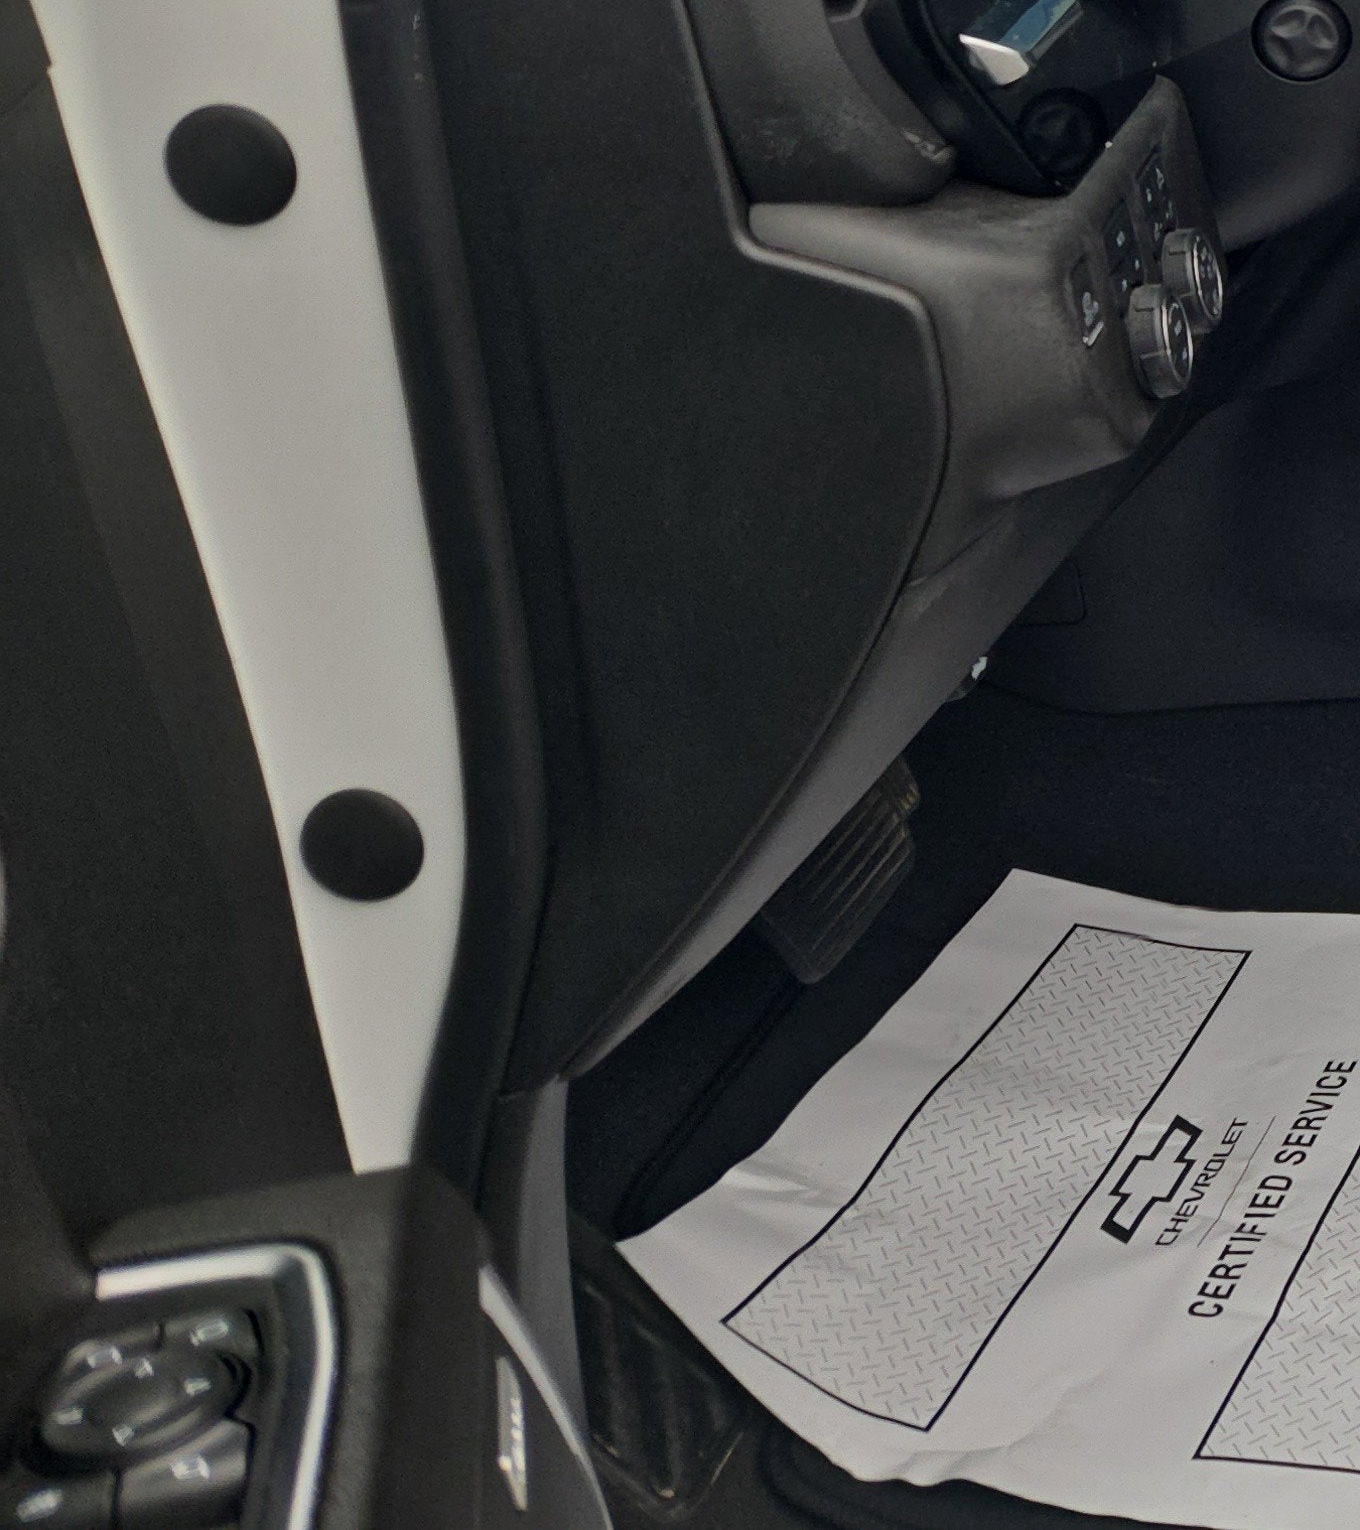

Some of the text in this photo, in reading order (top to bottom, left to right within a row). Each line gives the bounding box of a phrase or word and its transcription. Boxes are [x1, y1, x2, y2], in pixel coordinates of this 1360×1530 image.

[1155, 1118, 1249, 1247] CHEVROLET
[1188, 1059, 1358, 1318] CERTIFIED SERVICE
